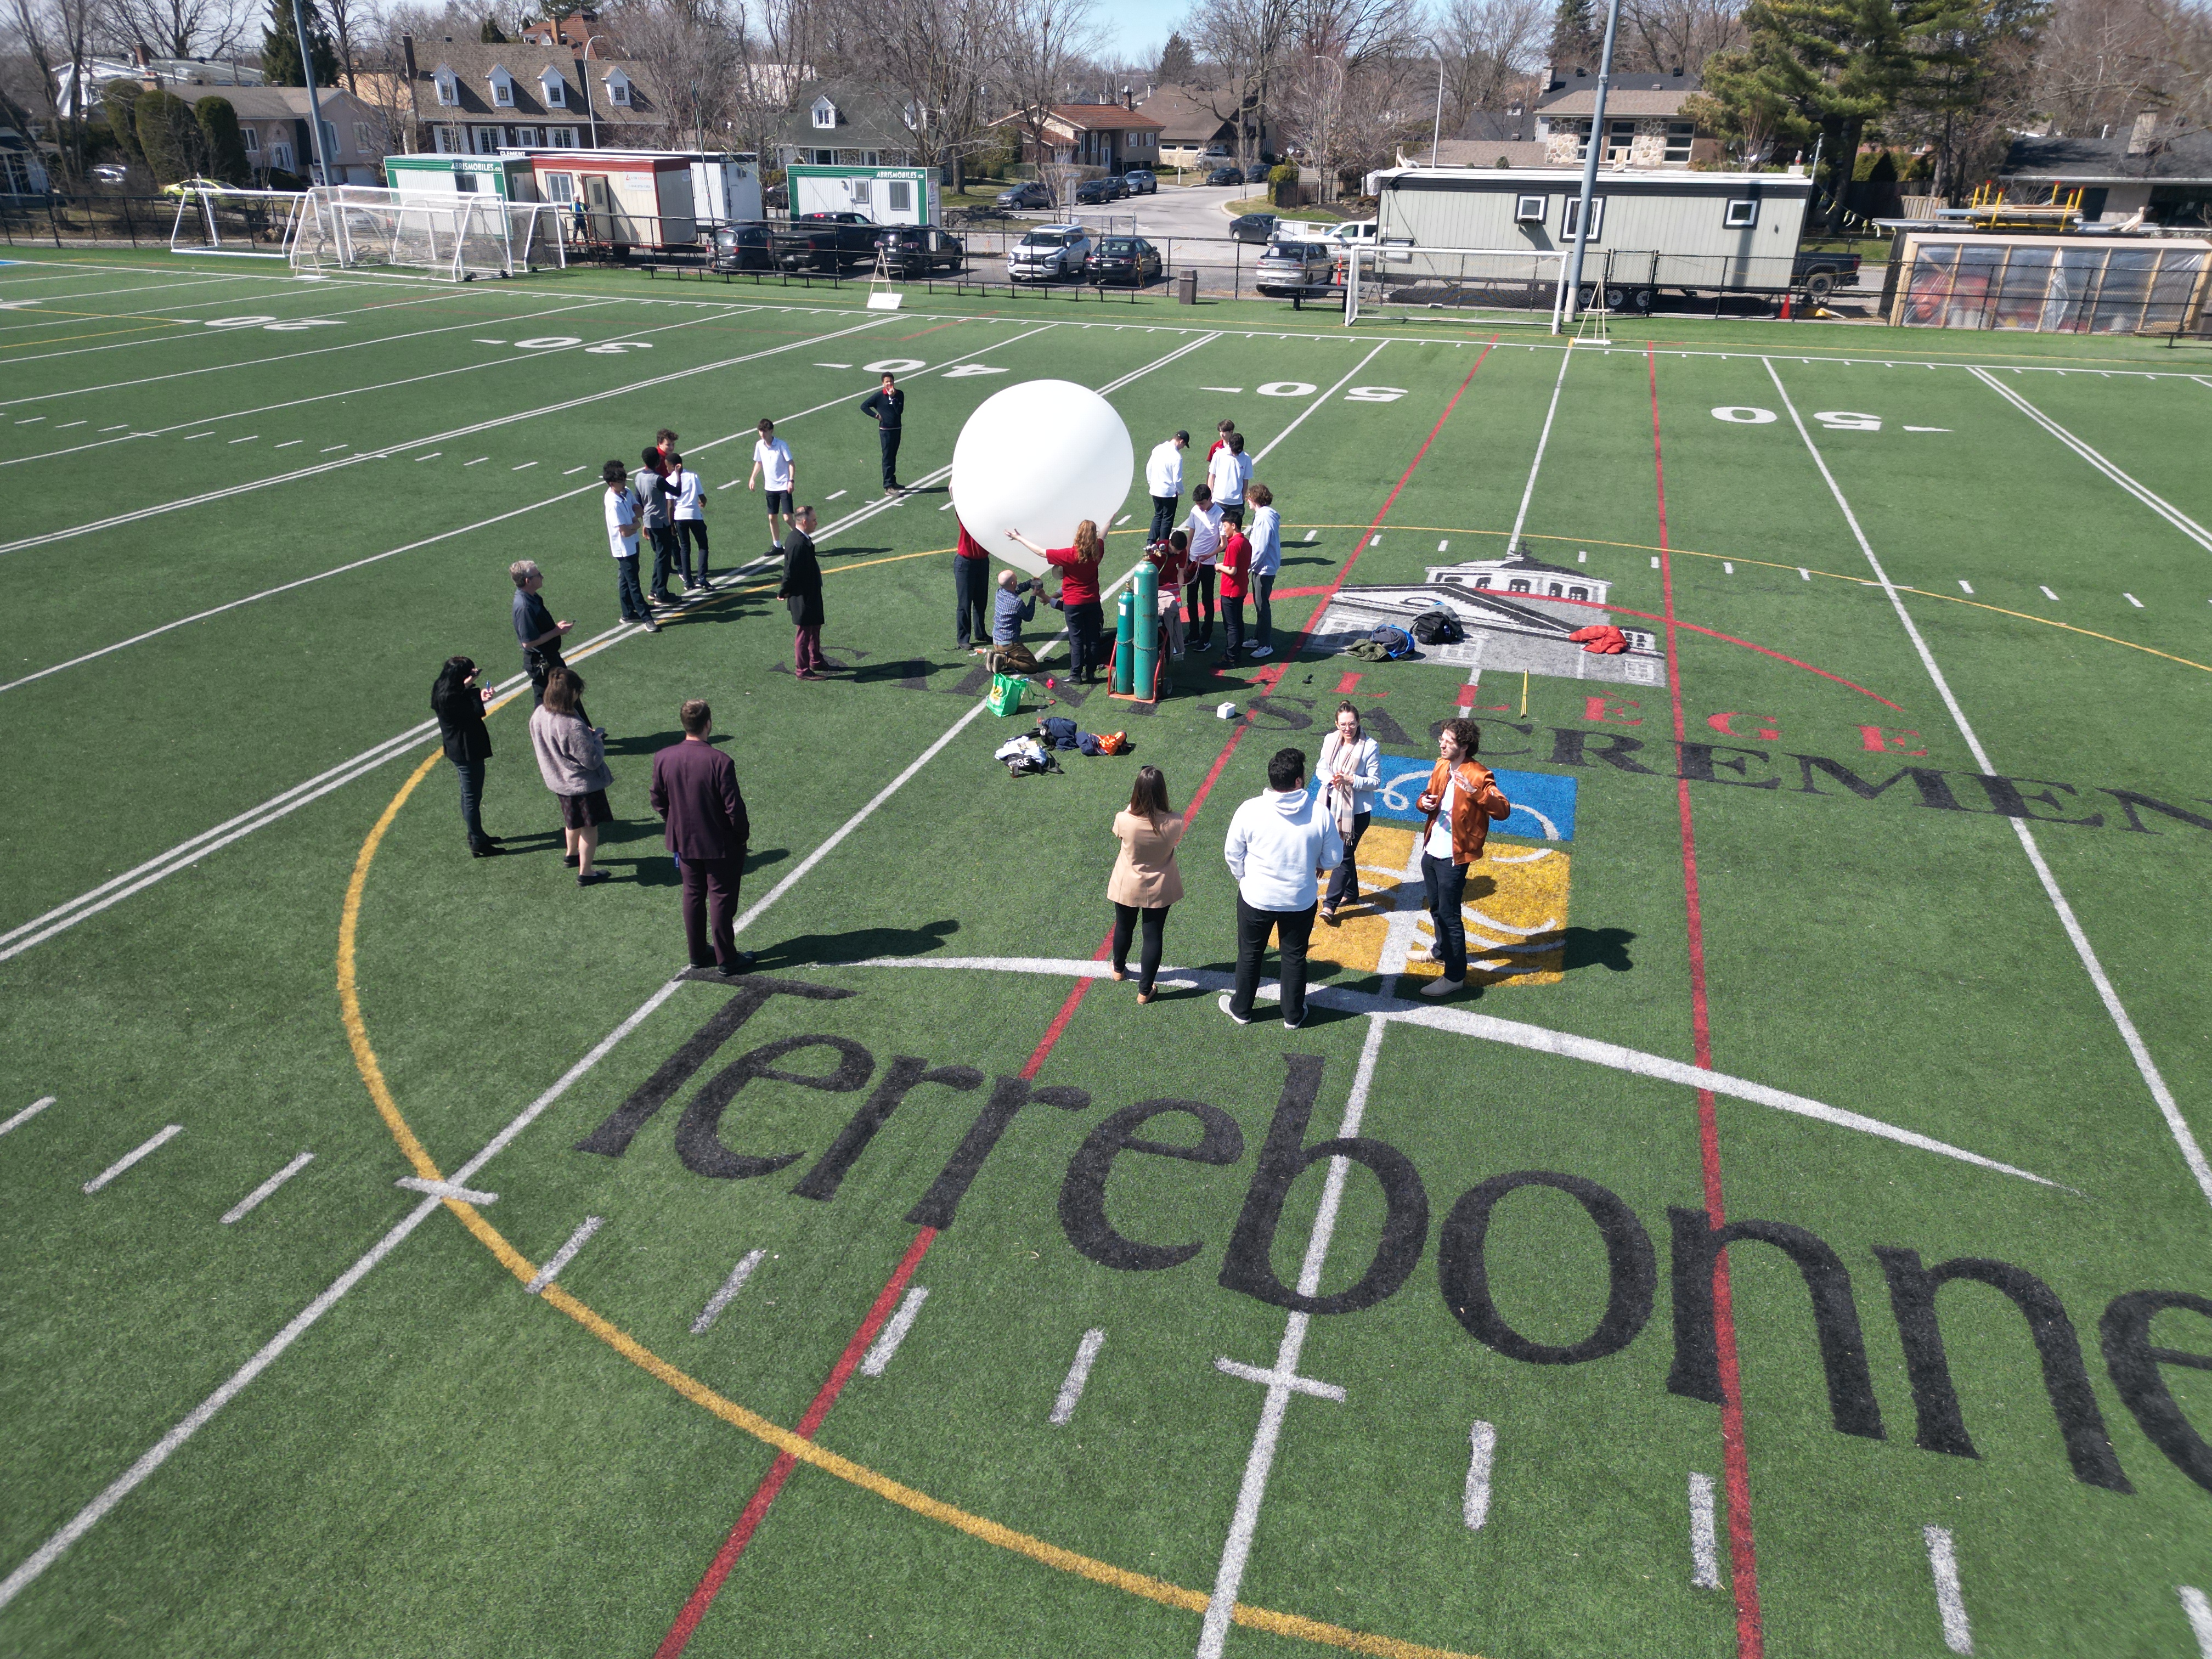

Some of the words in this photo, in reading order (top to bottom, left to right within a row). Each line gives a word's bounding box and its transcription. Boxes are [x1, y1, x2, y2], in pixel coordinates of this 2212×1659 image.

[862, 359, 1010, 377] 40
[1256, 382, 1408, 402] 50
[1711, 407, 1882, 431] 50
[572, 967, 2212, 1495] Terrebonne
